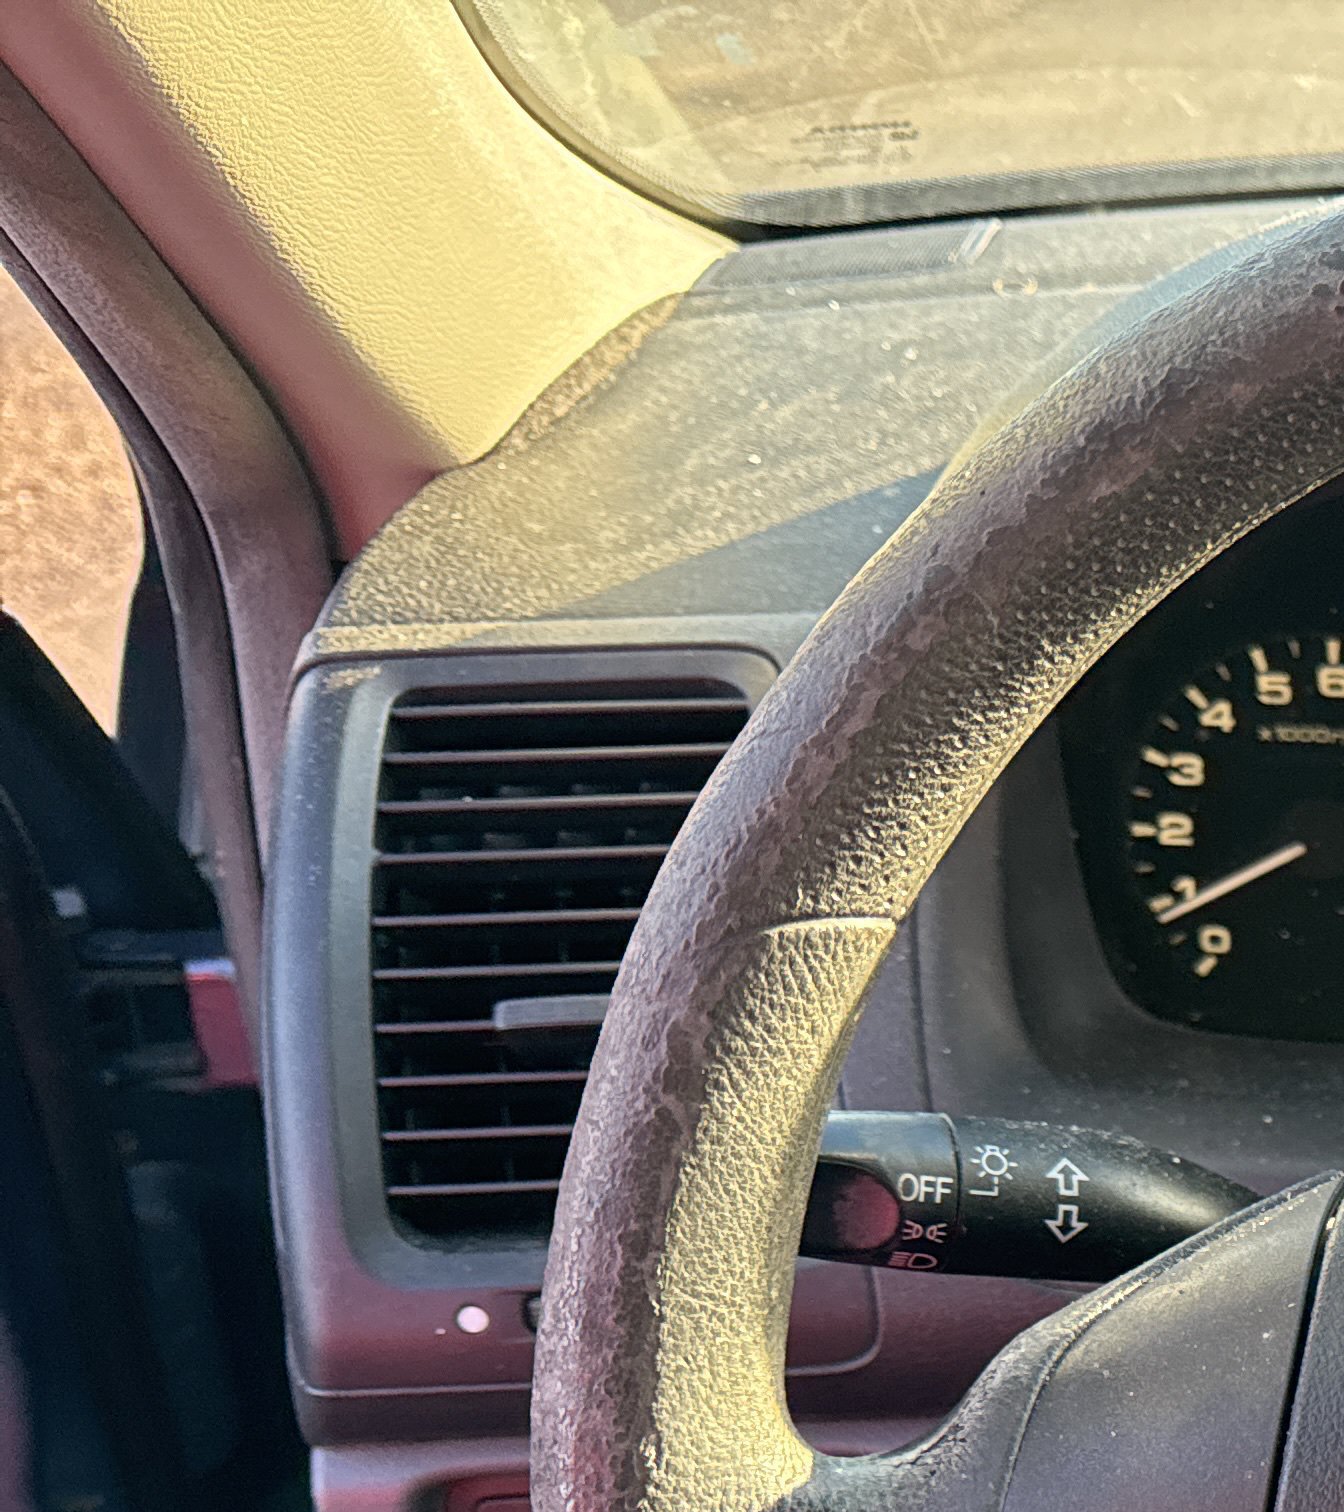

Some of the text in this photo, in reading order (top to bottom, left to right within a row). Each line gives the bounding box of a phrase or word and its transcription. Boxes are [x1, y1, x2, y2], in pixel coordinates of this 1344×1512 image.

[1256, 672, 1293, 706] 5
[1199, 700, 1236, 734] 4
[1168, 752, 1205, 787] 3
[1156, 812, 1195, 847] 2
[1199, 925, 1233, 955] 0
[899, 1172, 954, 1204] OFF
